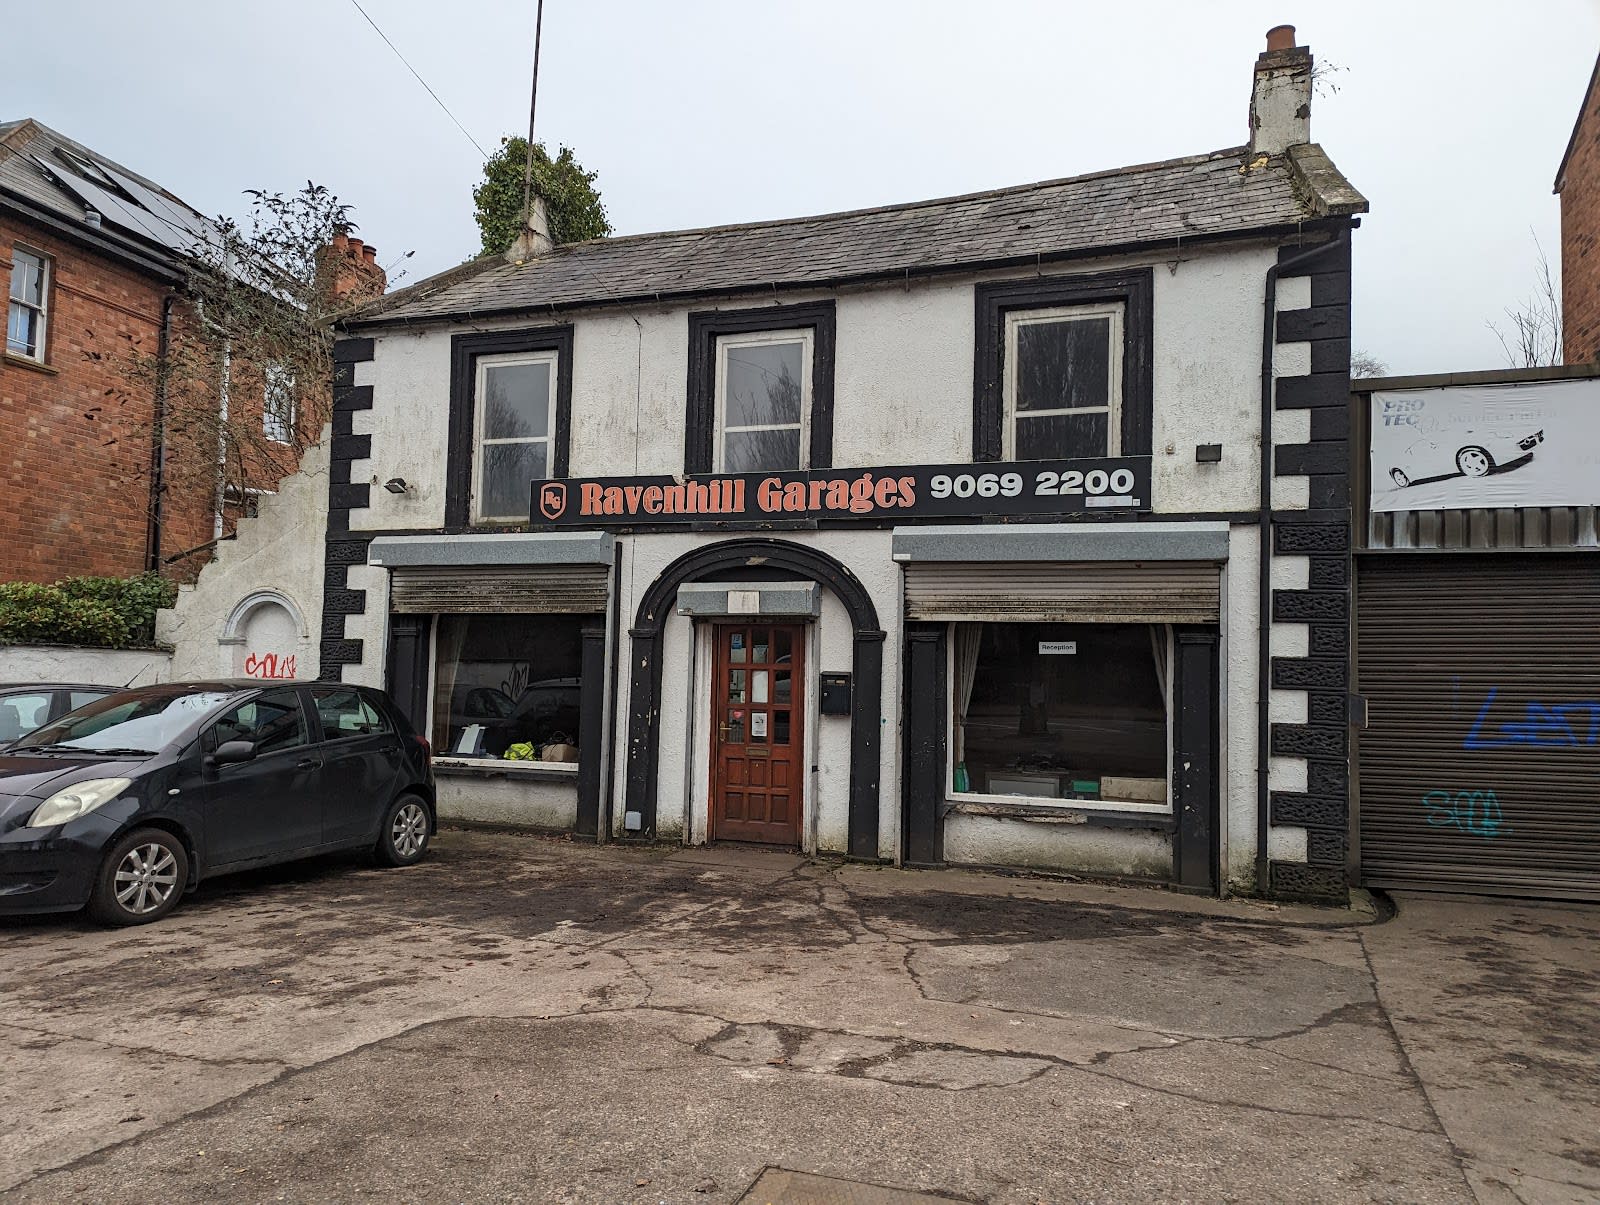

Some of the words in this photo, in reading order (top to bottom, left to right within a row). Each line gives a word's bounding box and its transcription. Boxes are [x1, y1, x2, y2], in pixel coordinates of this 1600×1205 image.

[1383, 399, 1426, 413] PRO
[1382, 414, 1418, 427] TEC
[579, 479, 746, 516] Ravenhill
[757, 472, 916, 514] Garages
[930, 472, 1023, 499] 9069
[1034, 468, 1135, 496] 2200
